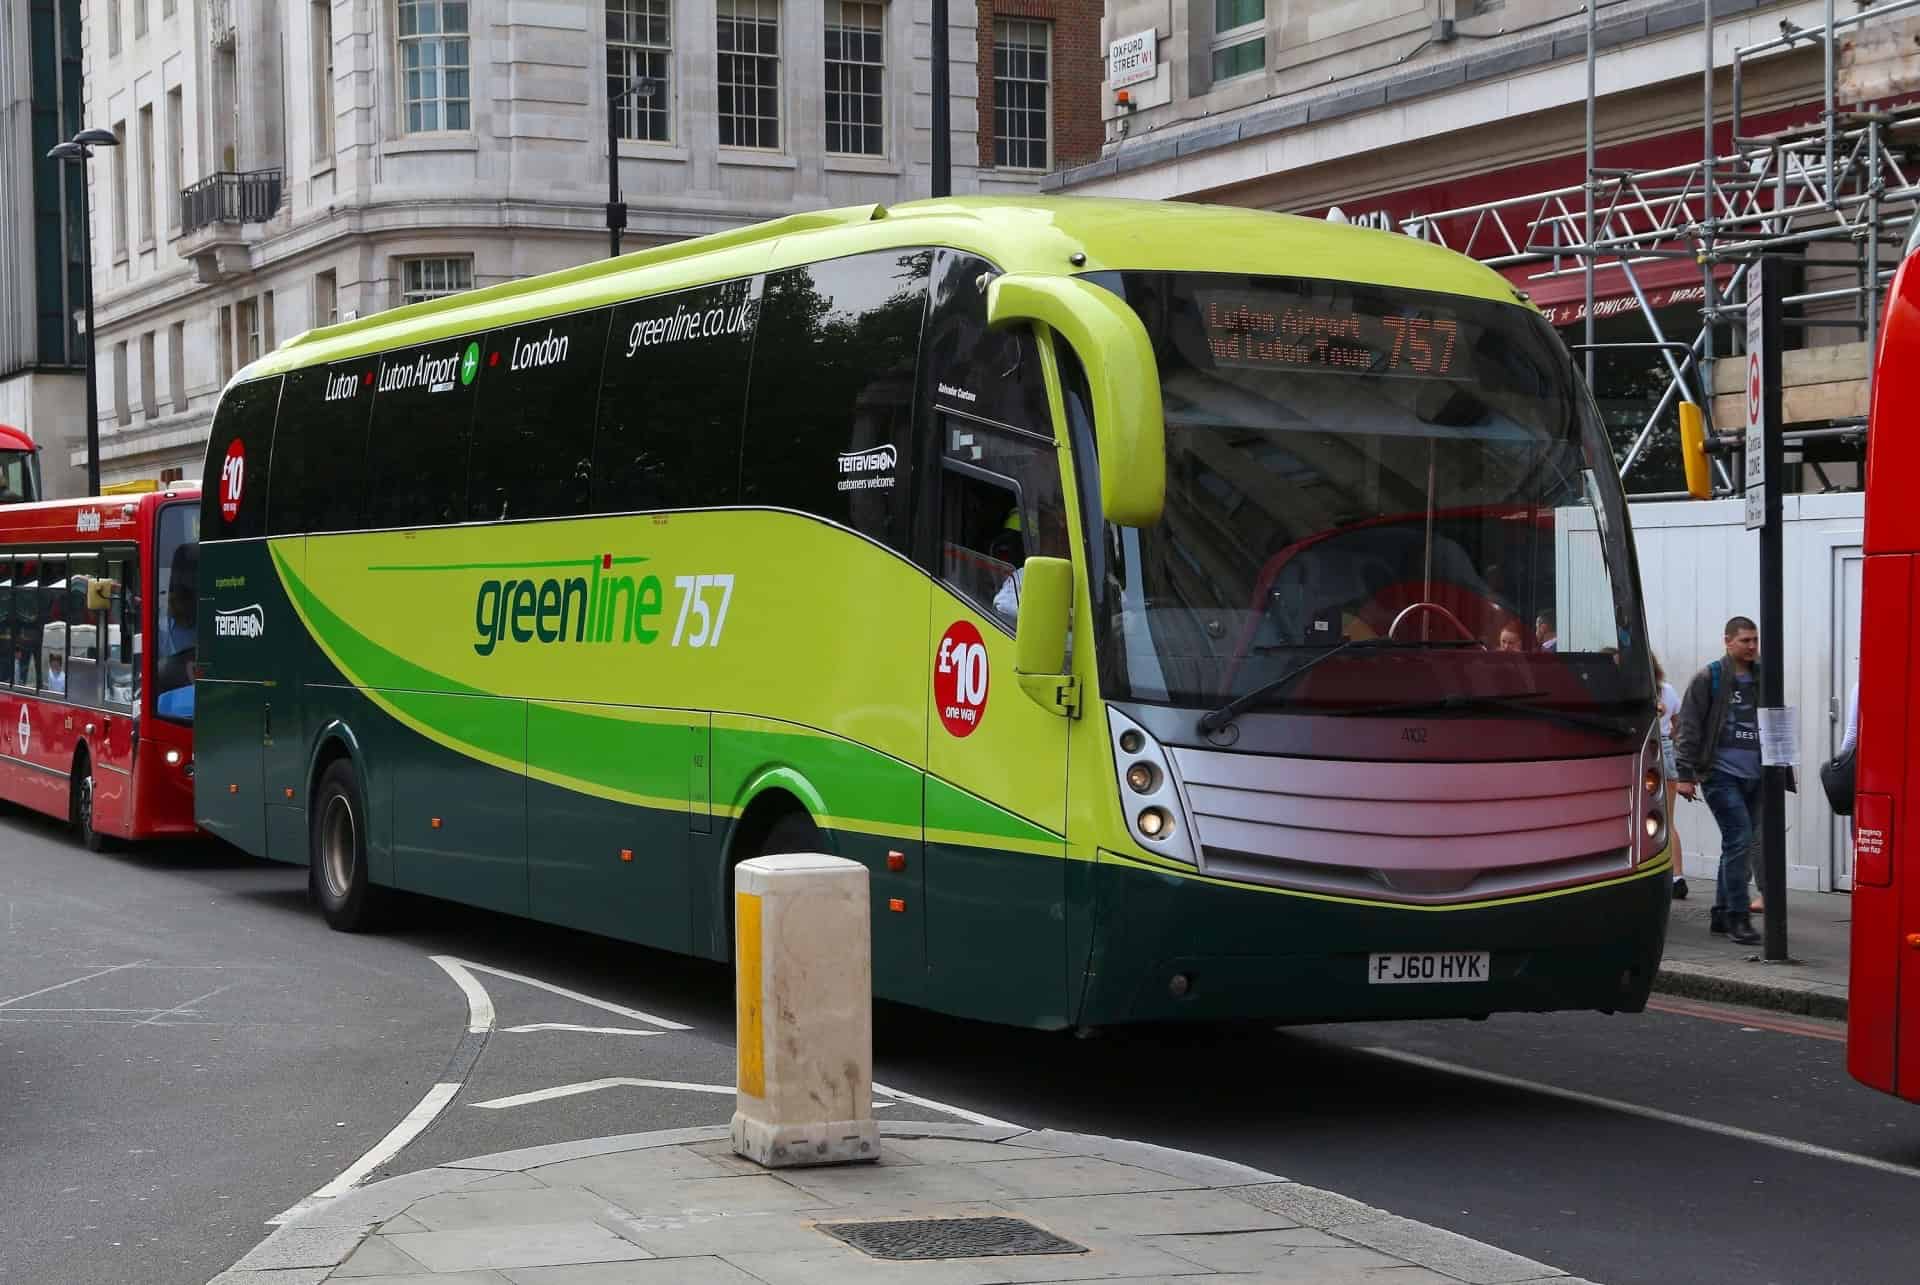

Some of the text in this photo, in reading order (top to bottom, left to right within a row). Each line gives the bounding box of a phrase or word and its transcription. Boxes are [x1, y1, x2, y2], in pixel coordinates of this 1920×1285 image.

[1113, 38, 1143, 58] OXFORD
[1113, 49, 1152, 73] STREET W1
[1576, 296, 1641, 319] SDWICHE
[626, 293, 752, 358] greenline.co.uk
[1209, 302, 1457, 375] Luton Airport 757
[1246, 333, 1312, 363] Luton
[325, 329, 568, 401] Luton Luton Airport London
[222, 455, 244, 500] £10
[838, 474, 895, 491] customers welcome
[474, 554, 735, 656] greenline 757
[939, 637, 988, 706] £10
[945, 706, 977, 726] one way
[1377, 955, 1481, 980] FJ60 HYK
